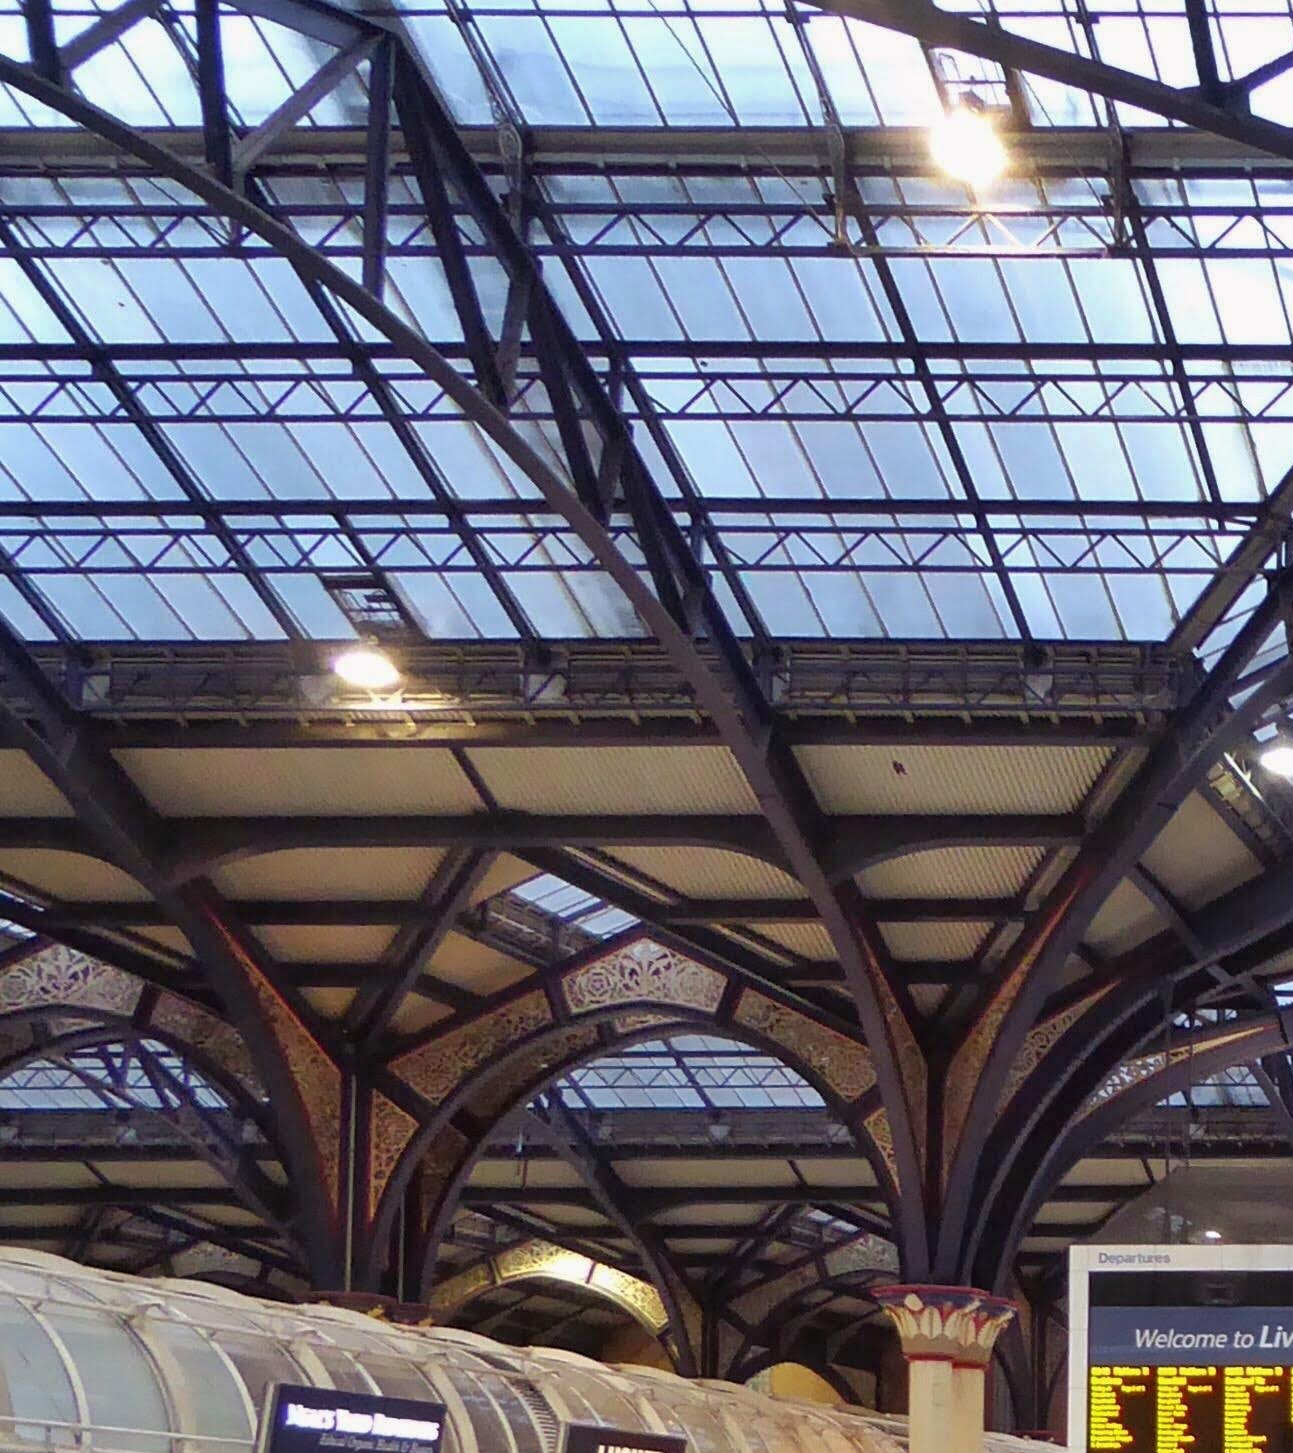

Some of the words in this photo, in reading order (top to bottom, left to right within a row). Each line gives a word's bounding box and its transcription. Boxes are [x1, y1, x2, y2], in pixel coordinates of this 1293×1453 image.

[1098, 1252, 1170, 1265] Departures
[1136, 1328, 1227, 1350] Welcome
[1234, 1331, 1254, 1349] to
